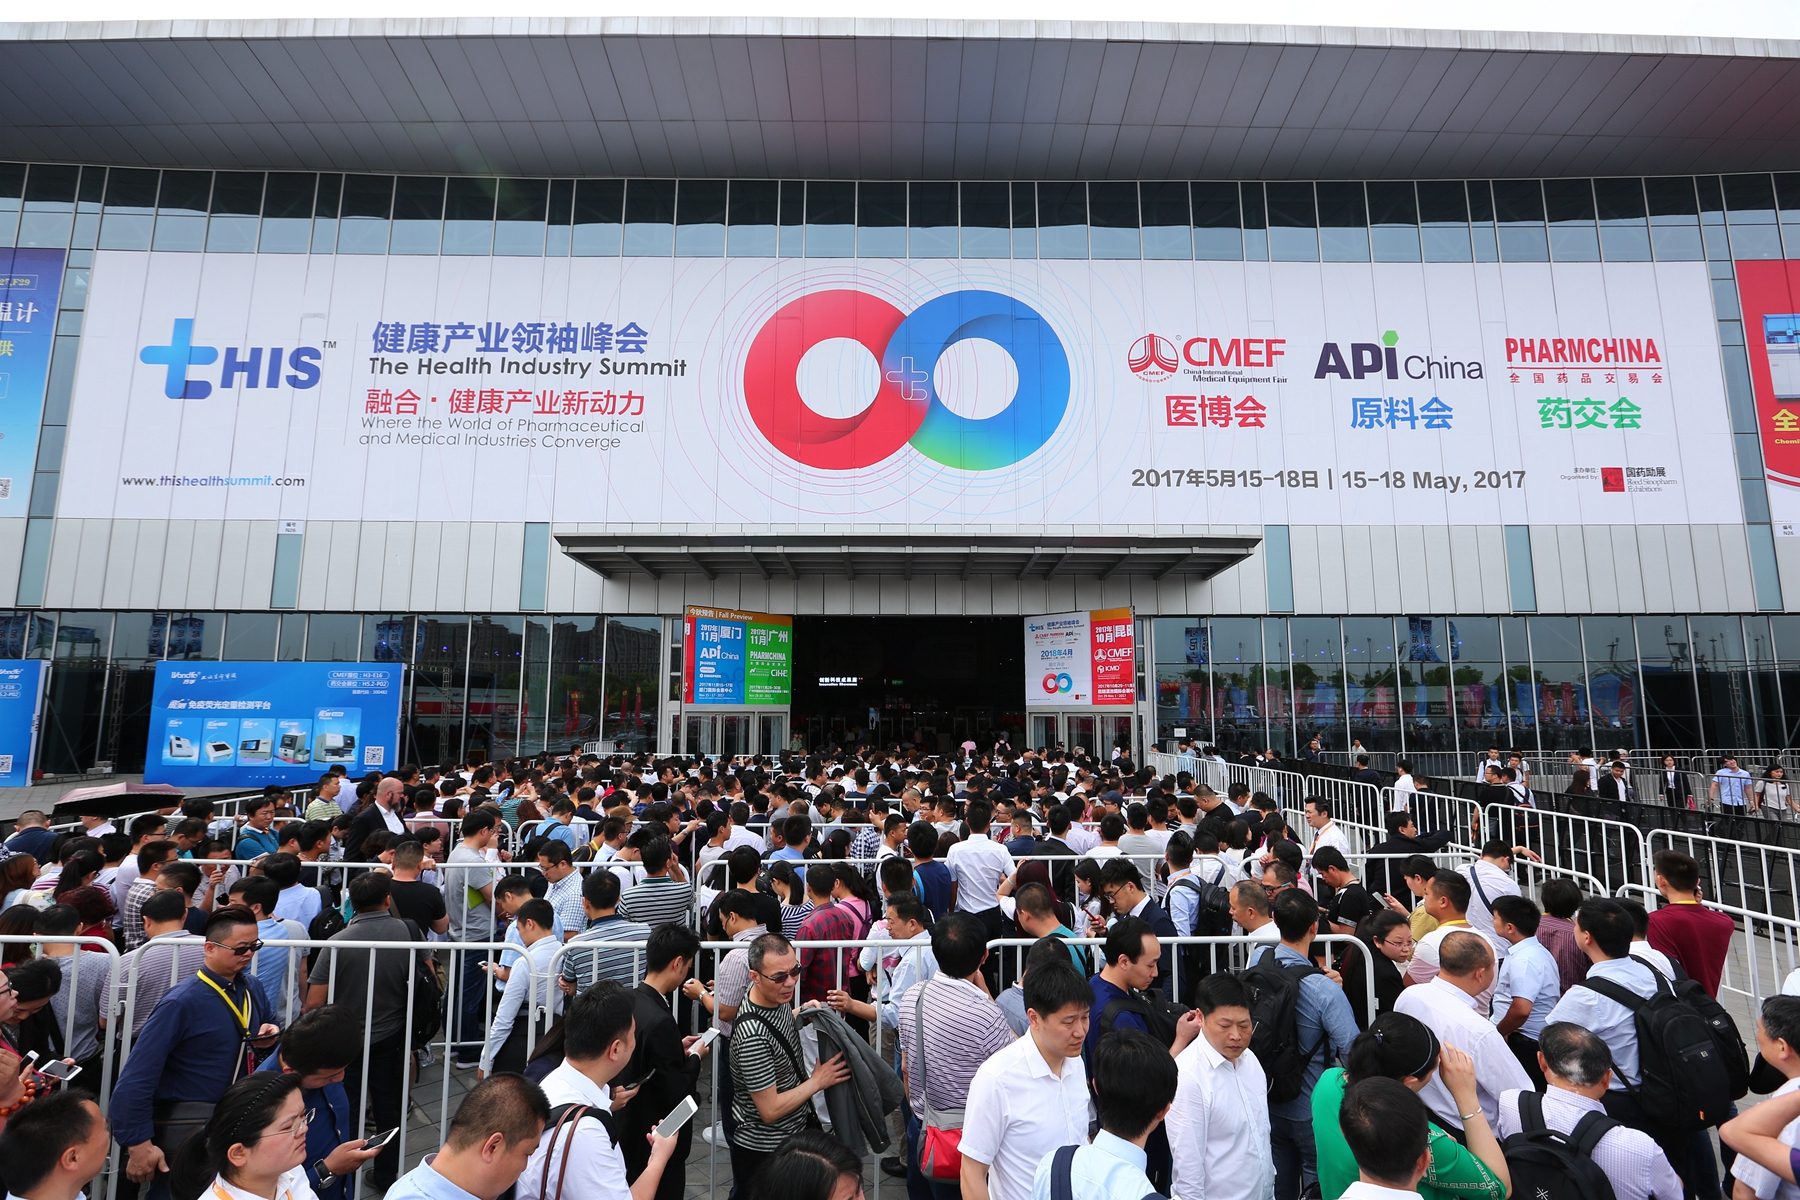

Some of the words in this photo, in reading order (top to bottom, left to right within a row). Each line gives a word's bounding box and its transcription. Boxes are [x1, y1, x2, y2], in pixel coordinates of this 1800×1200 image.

[372, 321, 649, 355] 健康产业领袖峰会
[1182, 338, 1286, 368] CMEF
[1505, 338, 1660, 362] PHARMCHINA
[369, 357, 409, 374] The
[417, 357, 492, 374] Health
[500, 356, 592, 378] Industry
[599, 358, 686, 377] Summit
[1404, 355, 1484, 380] China
[1228, 376, 1270, 384] Equipment
[1509, 372, 1662, 384] 全国药品交易会
[1166, 394, 1266, 428] 医博会
[1350, 396, 1454, 430] 原料会
[1537, 397, 1642, 430] 药交会
[360, 416, 412, 430] Where
[418, 417, 442, 430] the
[447, 417, 492, 430] World
[497, 418, 513, 431] of
[518, 418, 644, 433] Pharmaceutical
[1772, 408, 1800, 431] 全
[359, 432, 390, 445] and
[396, 432, 460, 446] Medical
[464, 434, 536, 448] Industries
[542, 435, 620, 450] Converge
[1626, 467, 1666, 477] 国药励展
[122, 475, 305, 488] www.thishealthsummit.com
[1342, 471, 1406, 488] 15-18
[1413, 471, 1468, 493] May,
[1474, 471, 1526, 488] 2017
[700, 624, 717, 632] 2017年
[720, 626, 742, 639] 厦门
[700, 632, 718, 642] 11月
[750, 636, 766, 646] 11月
[769, 630, 788, 642] 广州
[1096, 633, 1113, 642] 10月
[721, 652, 739, 660] China
[750, 651, 786, 661] PHARMCHINA
[1040, 649, 1072, 658] 2018年4月
[1107, 648, 1132, 658] CMEF
